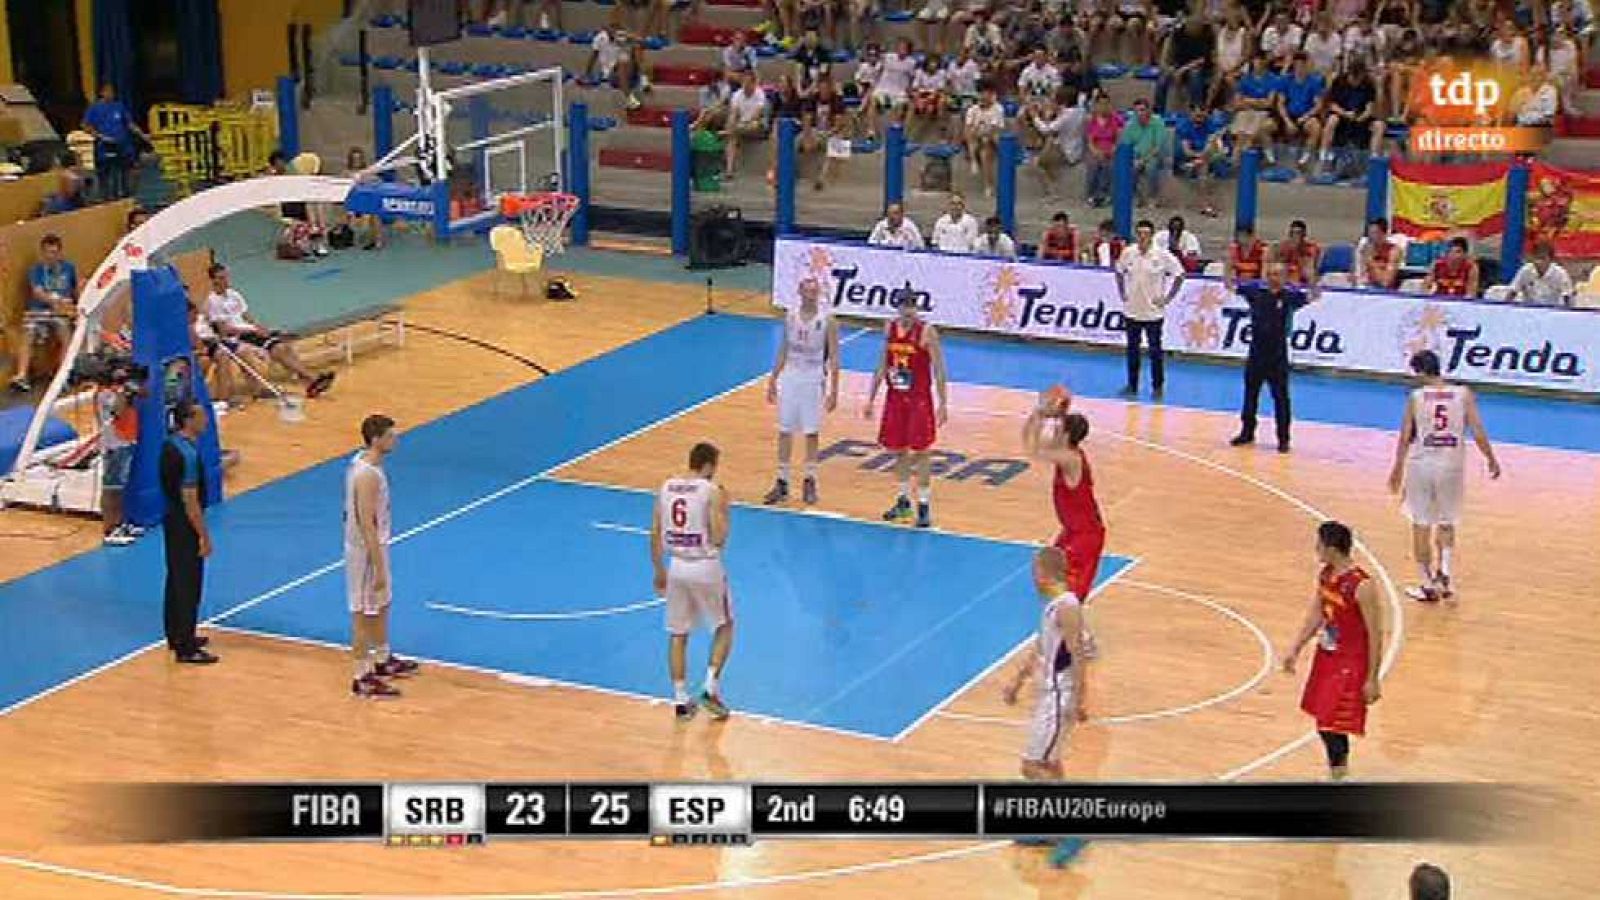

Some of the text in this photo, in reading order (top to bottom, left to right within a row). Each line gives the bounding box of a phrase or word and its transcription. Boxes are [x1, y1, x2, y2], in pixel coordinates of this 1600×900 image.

[1446, 324, 1585, 377] Tenda
[1434, 405, 1448, 431] 5
[672, 498, 687, 527] 6
